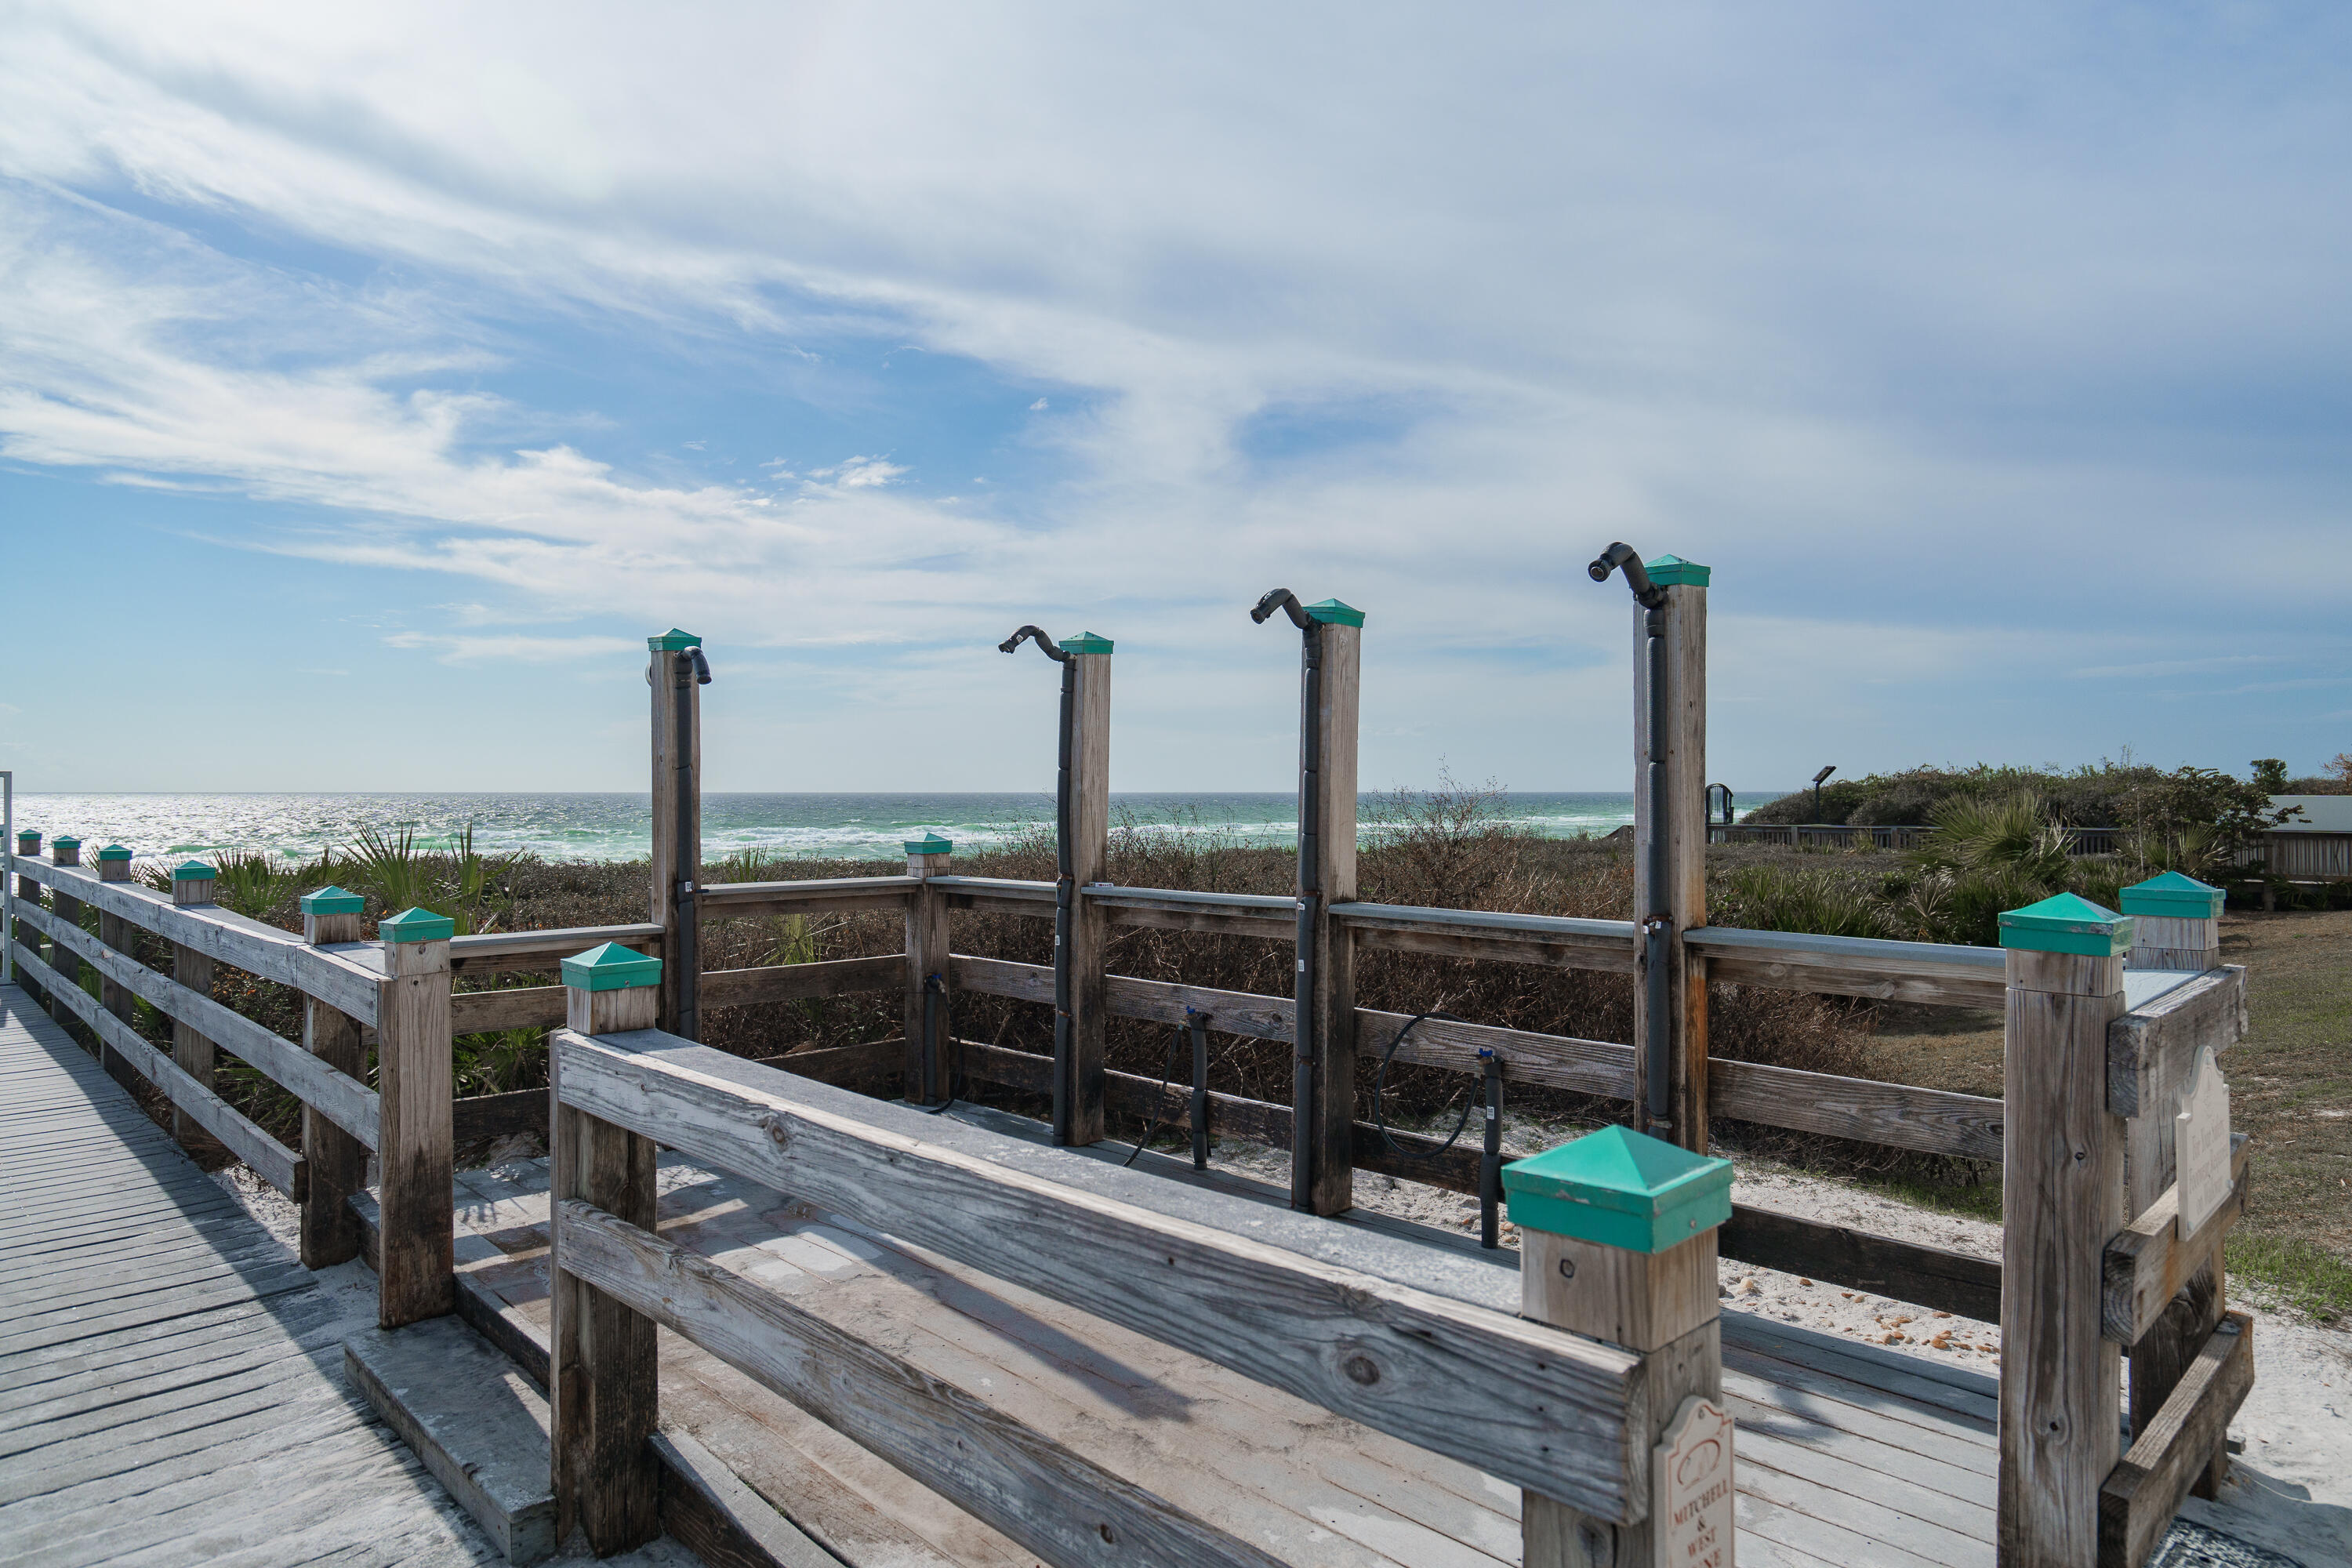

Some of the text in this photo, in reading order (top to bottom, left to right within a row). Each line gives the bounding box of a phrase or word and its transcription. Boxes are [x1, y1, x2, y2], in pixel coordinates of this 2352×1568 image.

[1674, 1478, 1729, 1526] MITCHELL
[1697, 1515, 1707, 1532] &
[1687, 1526, 1717, 1558] WEST
